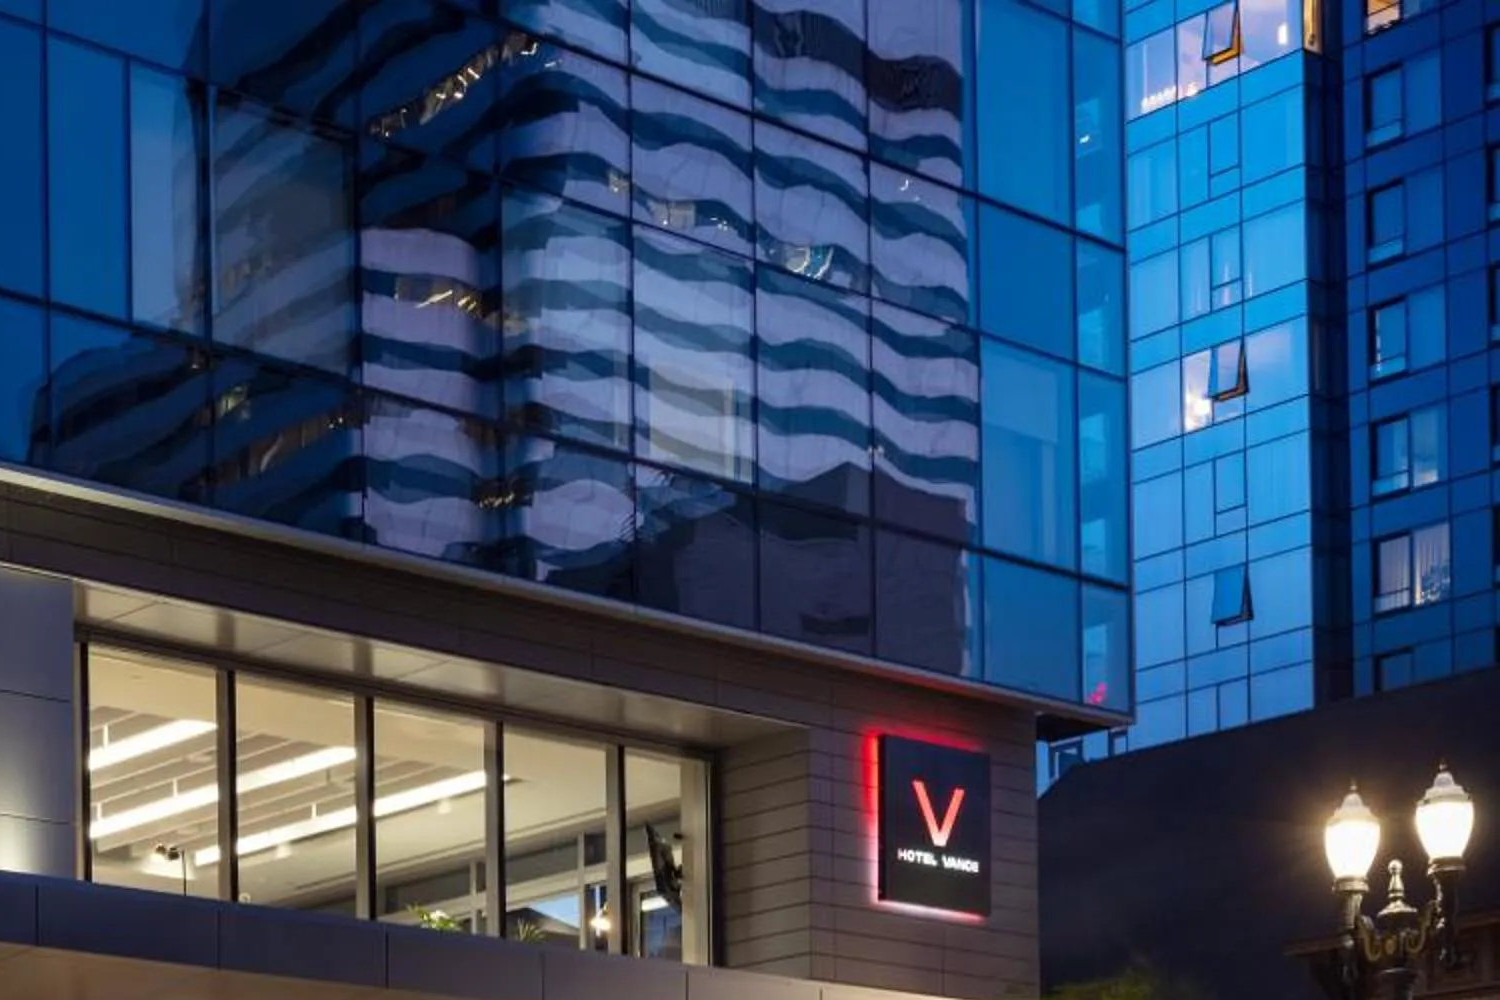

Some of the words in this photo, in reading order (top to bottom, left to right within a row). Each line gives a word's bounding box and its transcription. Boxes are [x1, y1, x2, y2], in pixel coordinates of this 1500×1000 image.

[912, 780, 965, 847] V
[897, 847, 938, 866] HOTEL
[941, 854, 980, 873] VANCE
